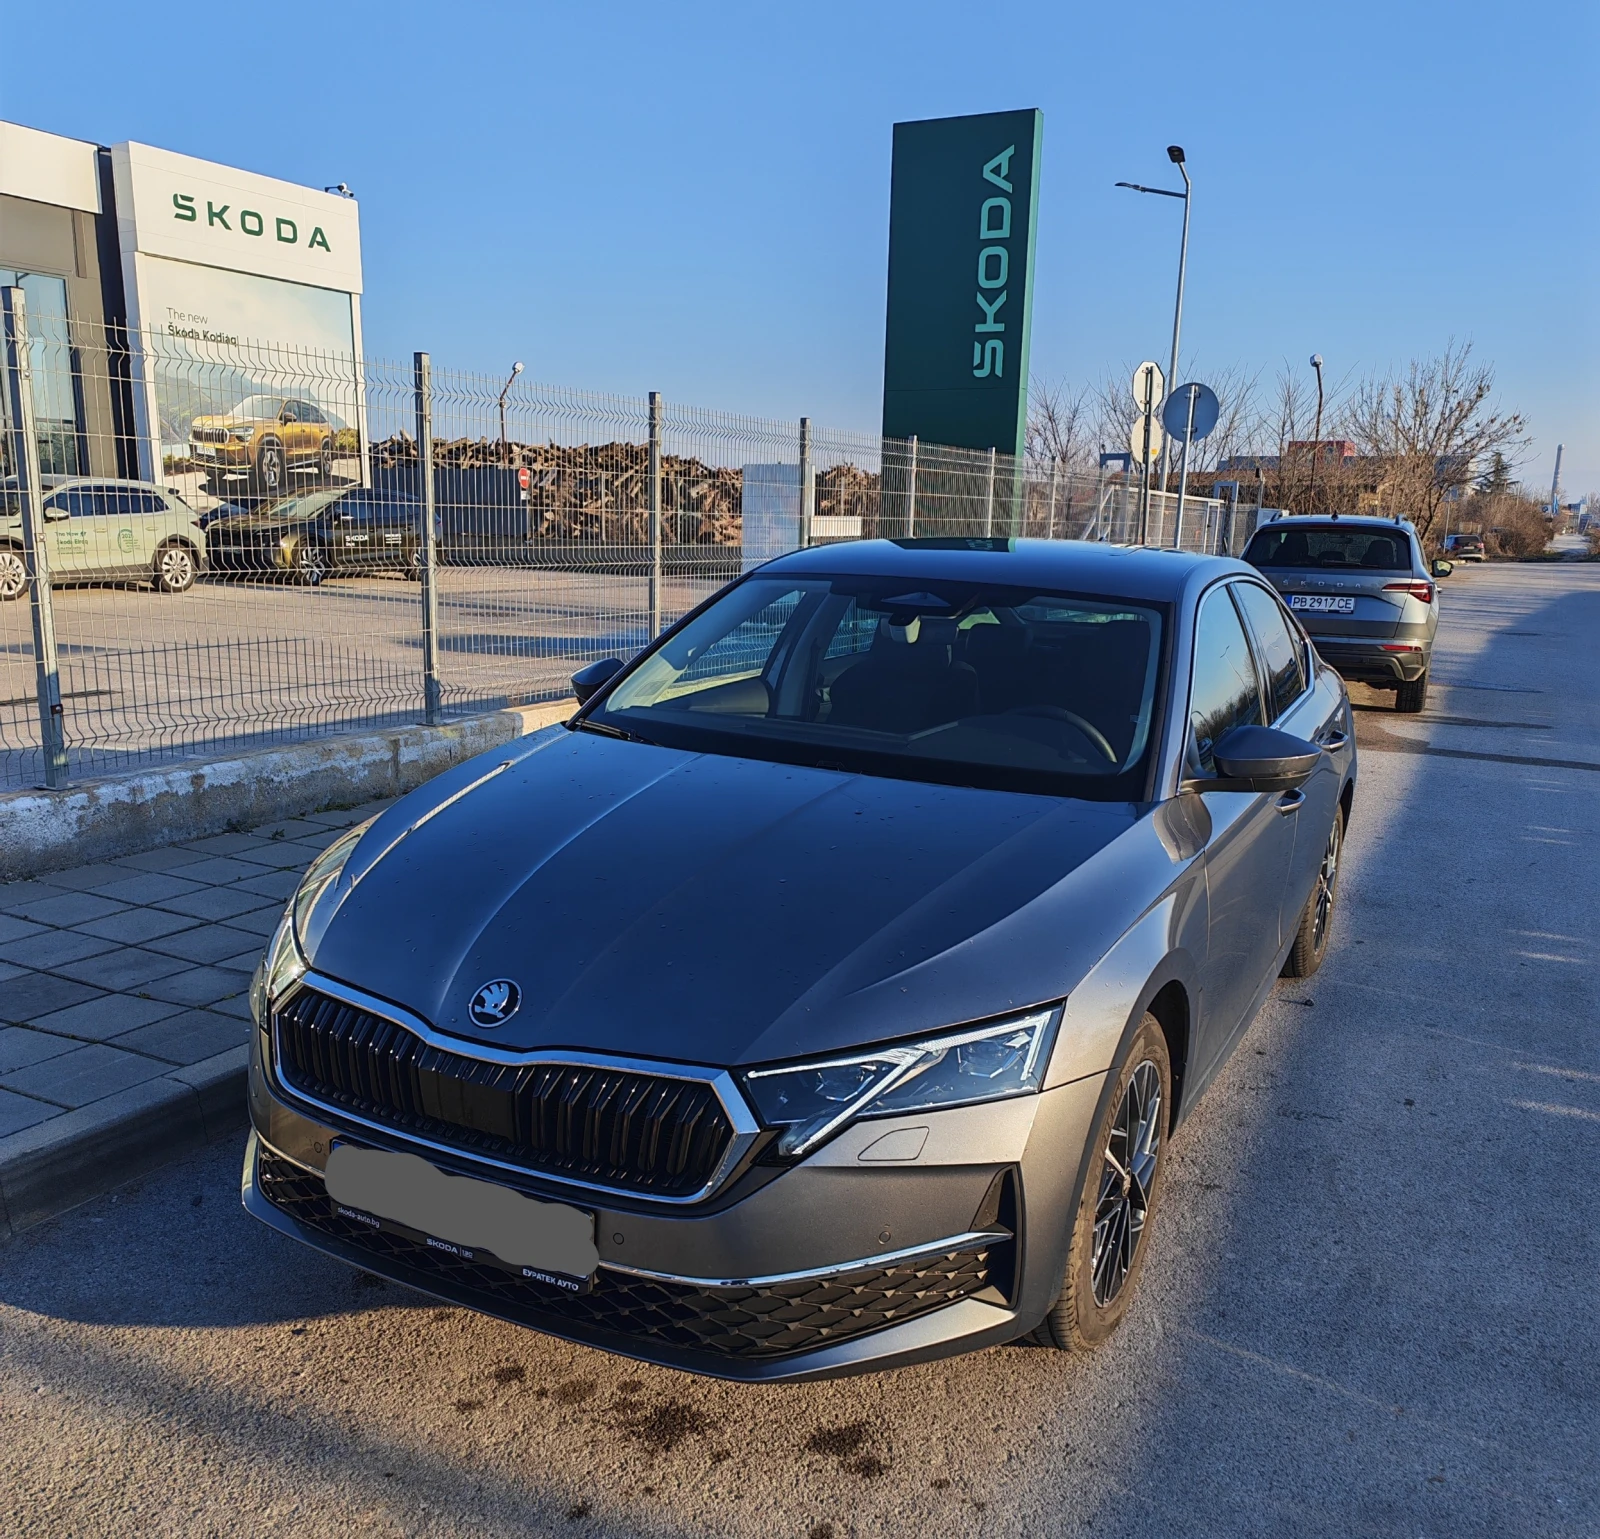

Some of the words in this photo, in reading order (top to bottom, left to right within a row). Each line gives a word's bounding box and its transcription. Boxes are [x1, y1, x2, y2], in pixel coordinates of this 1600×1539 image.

[166, 307, 186, 321] The
[187, 314, 208, 324] new
[202, 330, 237, 347] Kodiaq
[1292, 596, 1308, 607] PB
[1309, 597, 1336, 609] 2917
[1337, 598, 1353, 609] CE
[337, 1206, 380, 1229] skoda-auto.bg
[522, 1268, 556, 1285] ЕУРАТЕК
[556, 1279, 579, 1291] АУТО
